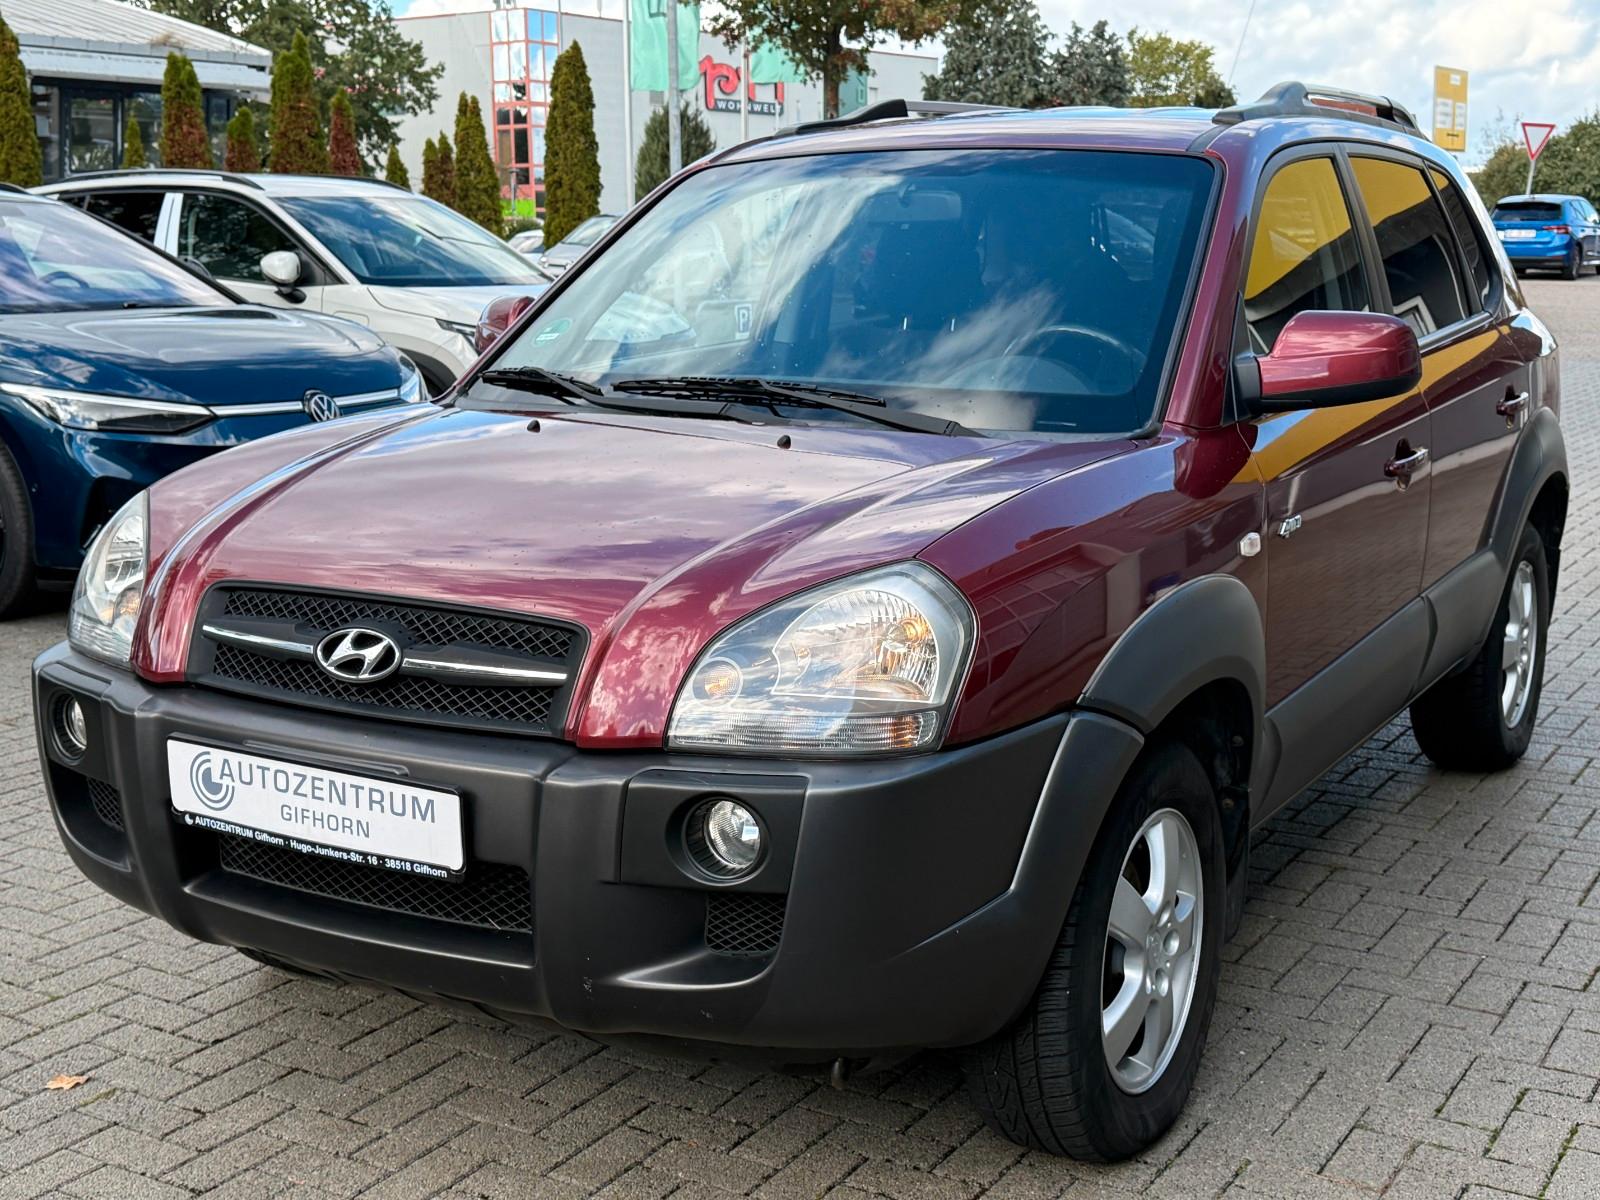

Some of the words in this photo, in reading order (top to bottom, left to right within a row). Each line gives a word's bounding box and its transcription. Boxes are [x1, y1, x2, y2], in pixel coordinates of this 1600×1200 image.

[219, 757, 436, 824] AUTOZENTRUM
[280, 803, 370, 839] GIFHORN
[195, 815, 254, 839] AUTOZENTRUM
[254, 830, 285, 846] Gifhorn
[289, 838, 366, 864] Hugo-Junkers-Str.
[366, 855, 378, 866] 16
[384, 857, 412, 872] 38518
[413, 863, 448, 879] Gifhorn
